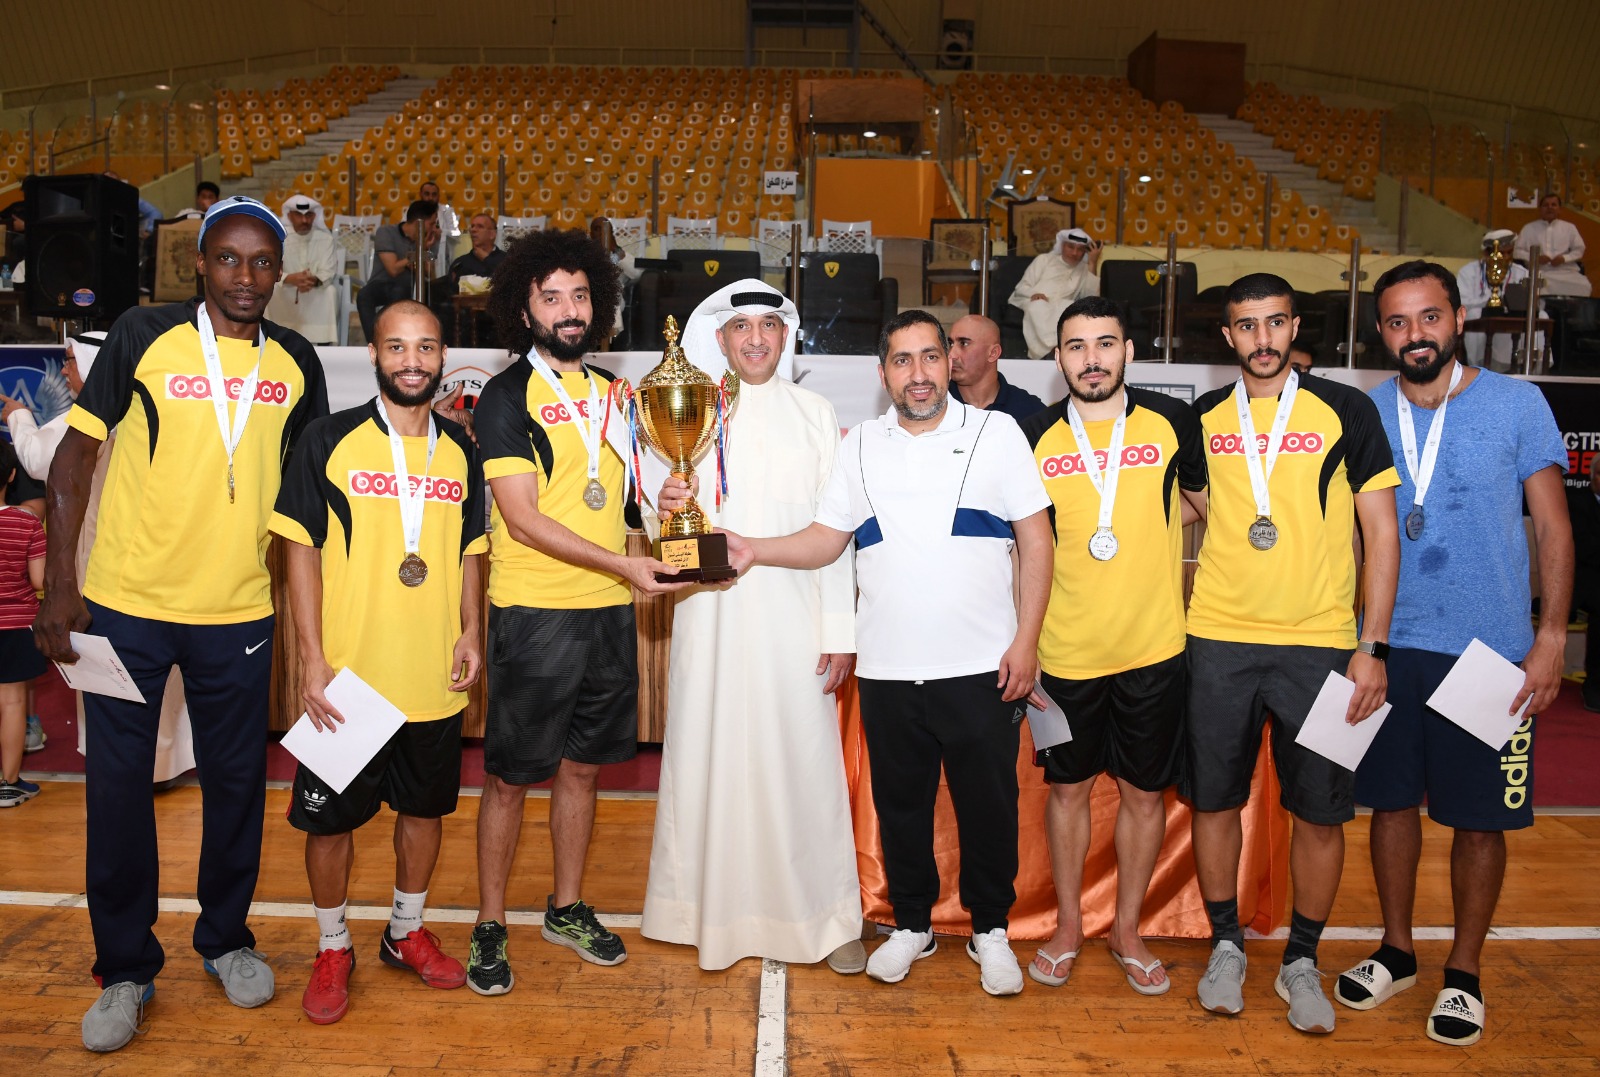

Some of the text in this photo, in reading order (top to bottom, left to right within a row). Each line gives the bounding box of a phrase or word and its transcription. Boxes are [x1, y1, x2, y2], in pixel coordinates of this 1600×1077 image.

[169, 376, 288, 404] ooeoo
[437, 380, 482, 394] UTS
[1439, 1003, 1475, 1018] adidas
